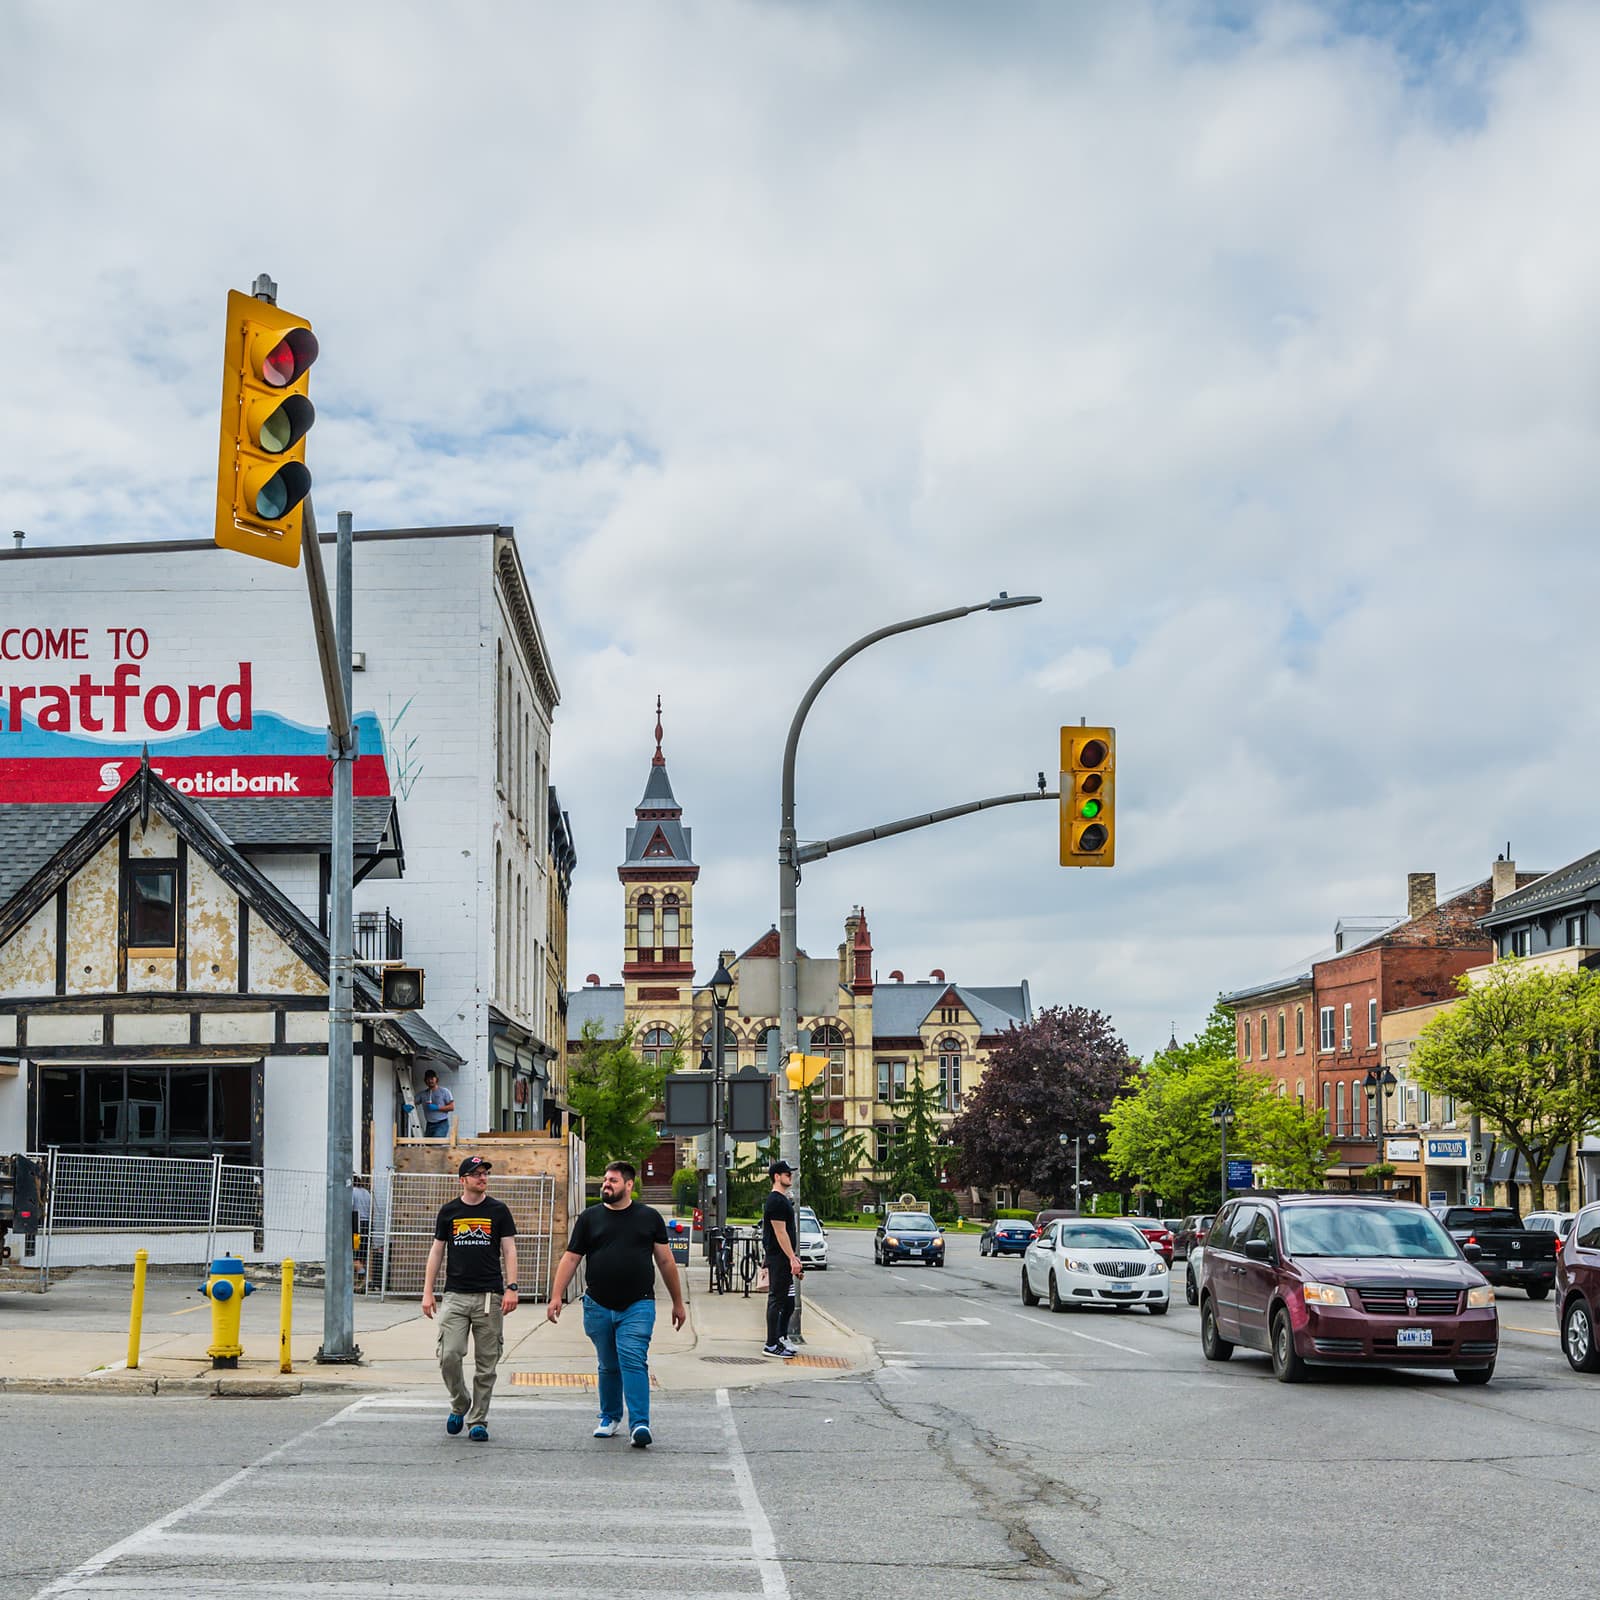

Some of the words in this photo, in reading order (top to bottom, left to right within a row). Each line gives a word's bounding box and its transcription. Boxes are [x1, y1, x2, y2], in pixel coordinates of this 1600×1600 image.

[0, 628, 89, 661] COME
[107, 628, 149, 660] TO
[0, 661, 253, 733] ratford
[1475, 1152, 1482, 1161] 8
